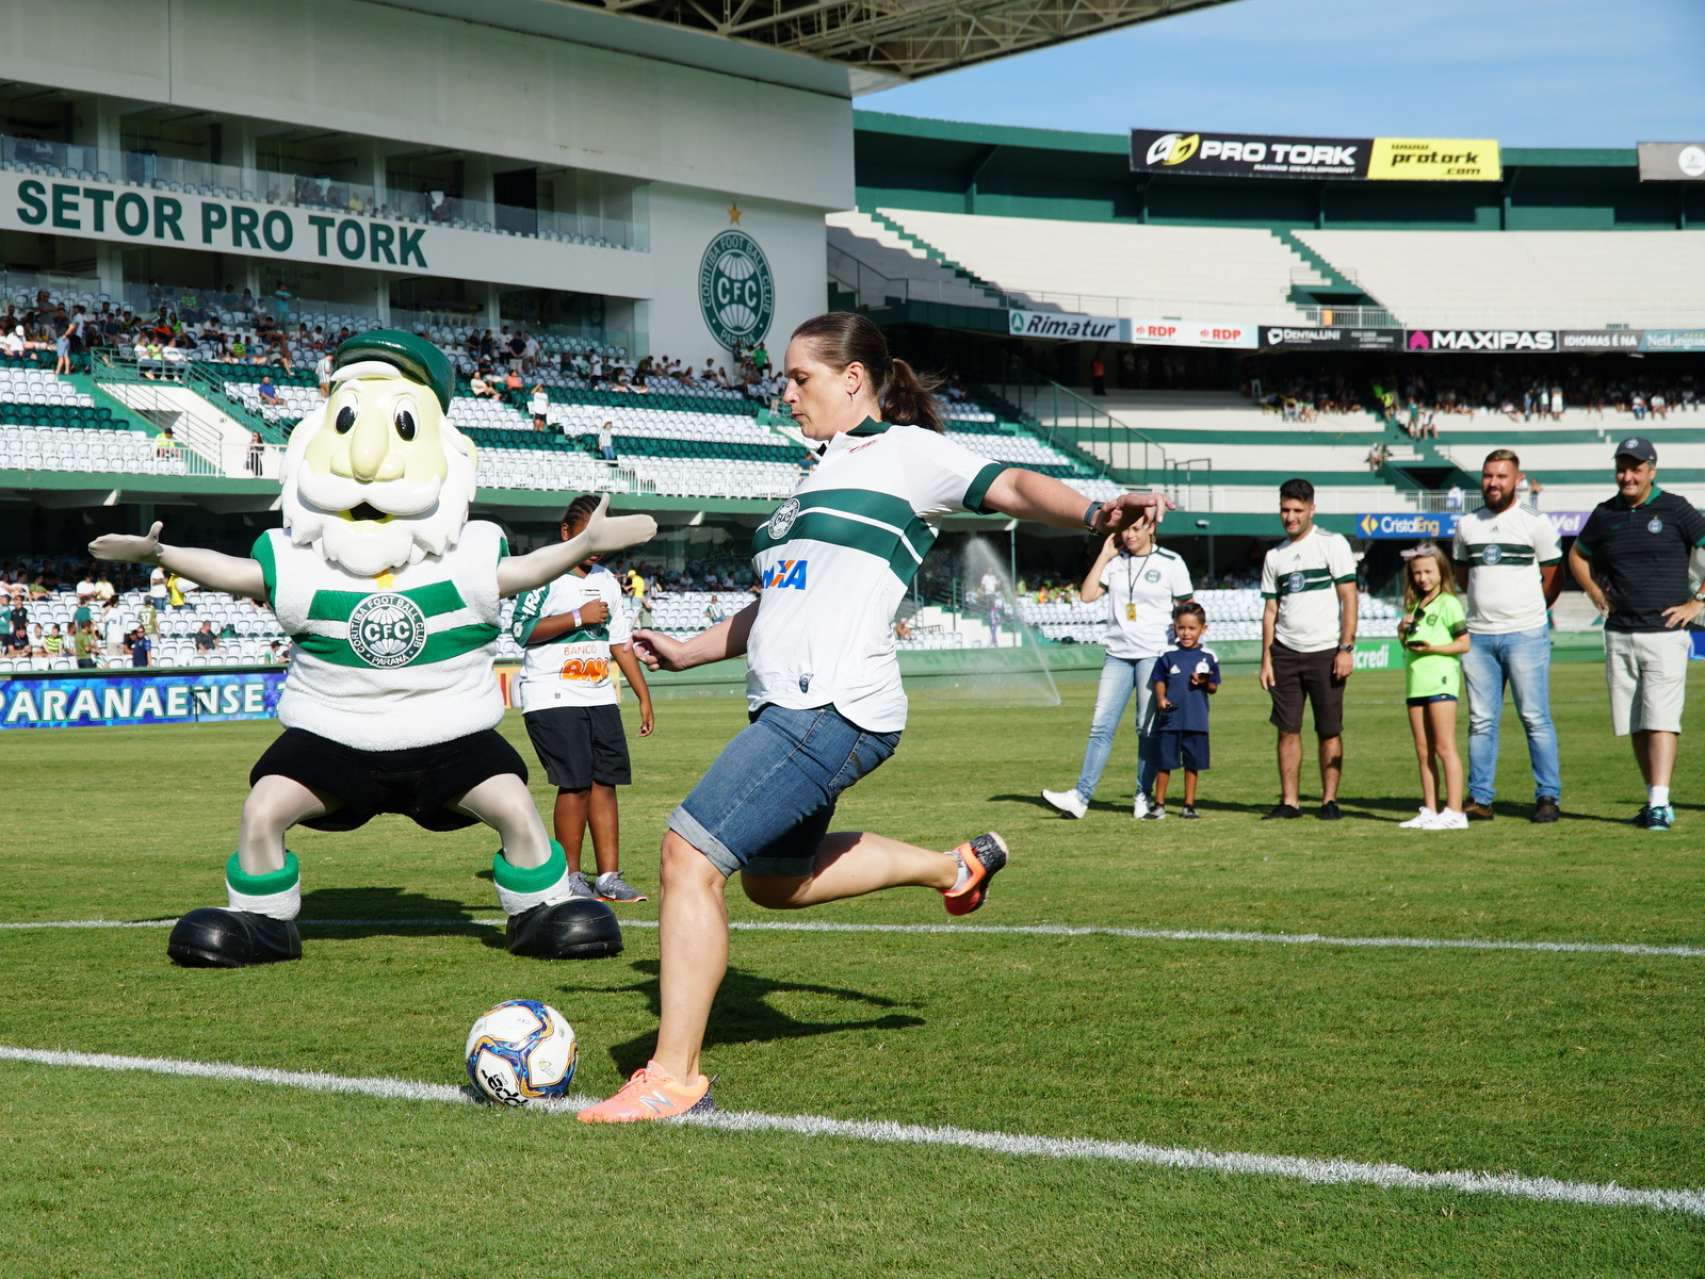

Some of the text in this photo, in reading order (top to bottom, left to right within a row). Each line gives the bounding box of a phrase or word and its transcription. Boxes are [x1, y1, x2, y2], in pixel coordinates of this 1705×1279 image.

[1200, 140, 1358, 165] PRO TORK
[1391, 152, 1478, 167] protork
[17, 179, 428, 269] SETOR PRO TORK
[717, 277, 757, 308] CFC
[1027, 315, 1116, 337] Rimatur
[1148, 326, 1177, 337] RDP
[1212, 328, 1242, 340] RDP
[1432, 331, 1555, 350] MAXIPAS
[368, 596, 395, 609] FOOT
[396, 598, 419, 621] BALL
[364, 621, 410, 642] CFC
[0, 684, 265, 722] ARANAENSE
